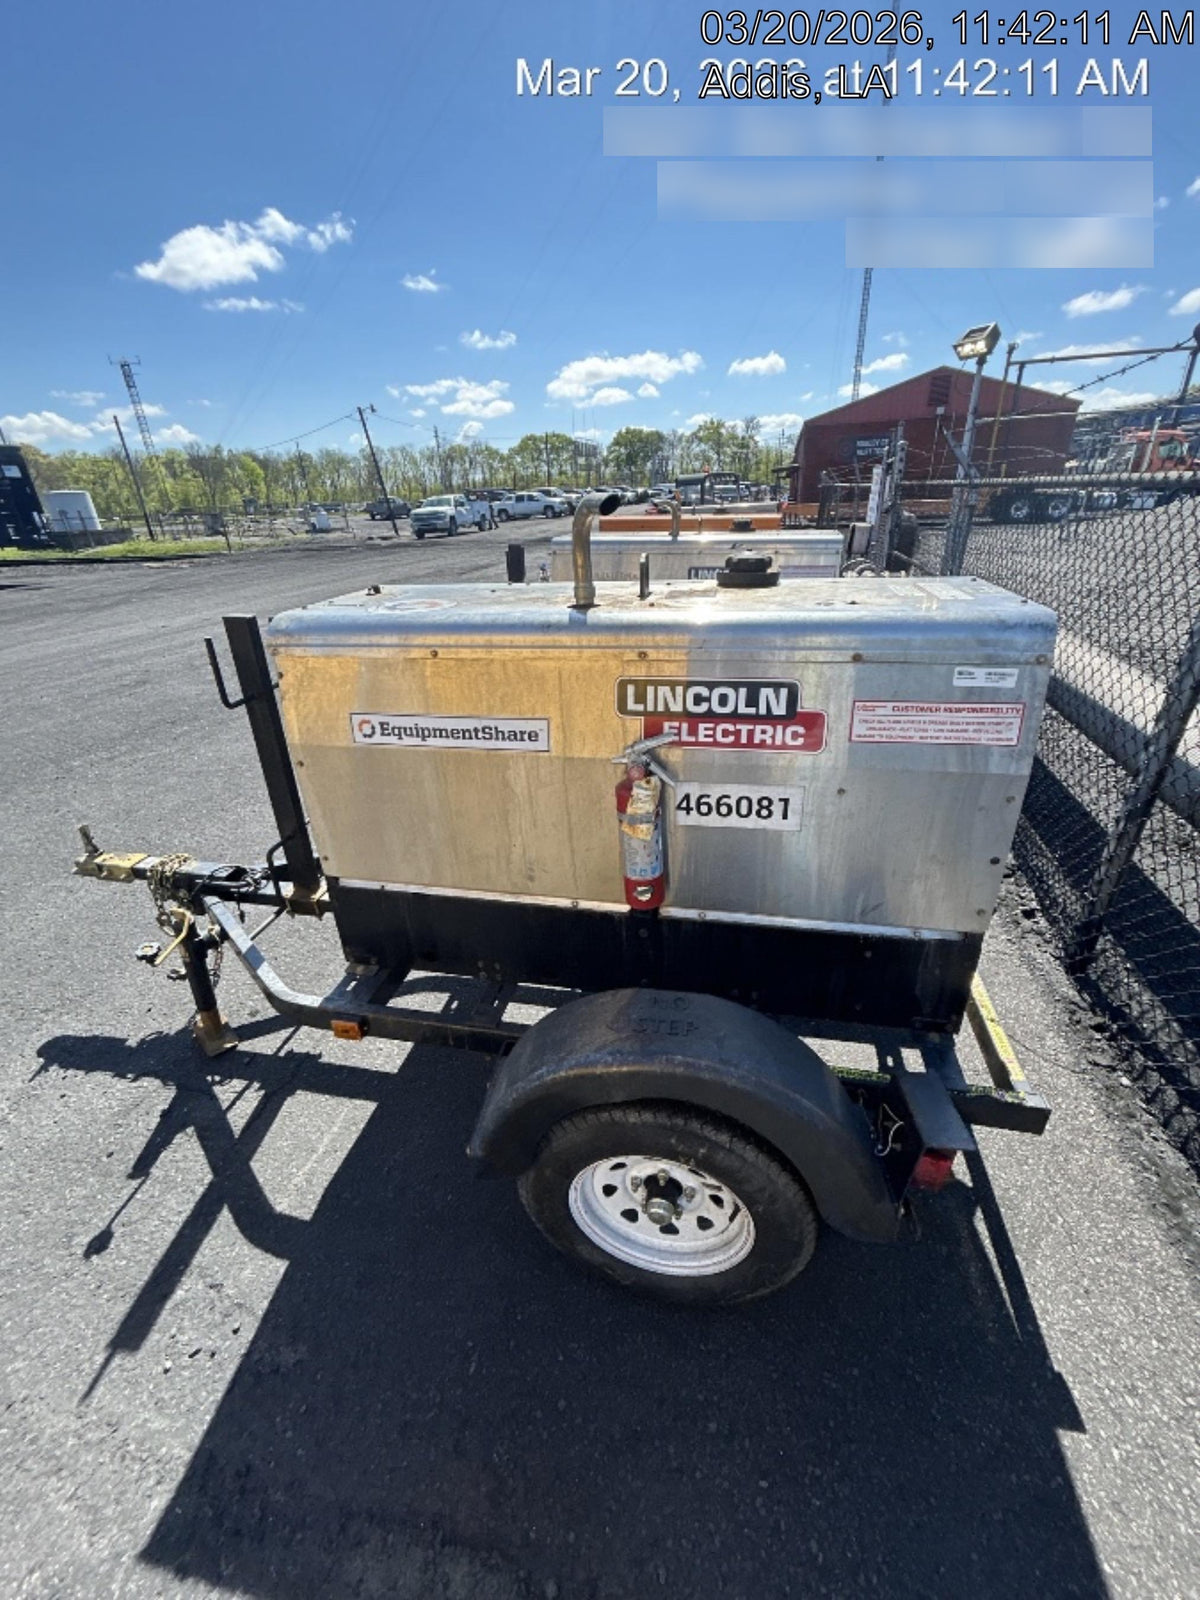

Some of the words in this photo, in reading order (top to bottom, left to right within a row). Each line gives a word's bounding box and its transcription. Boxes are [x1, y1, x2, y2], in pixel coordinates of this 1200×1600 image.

[626, 683, 789, 716] LINCOLN
[378, 721, 540, 743] EquipmentShare
[662, 721, 807, 746] ELECTRIC
[676, 792, 791, 821] 466081
